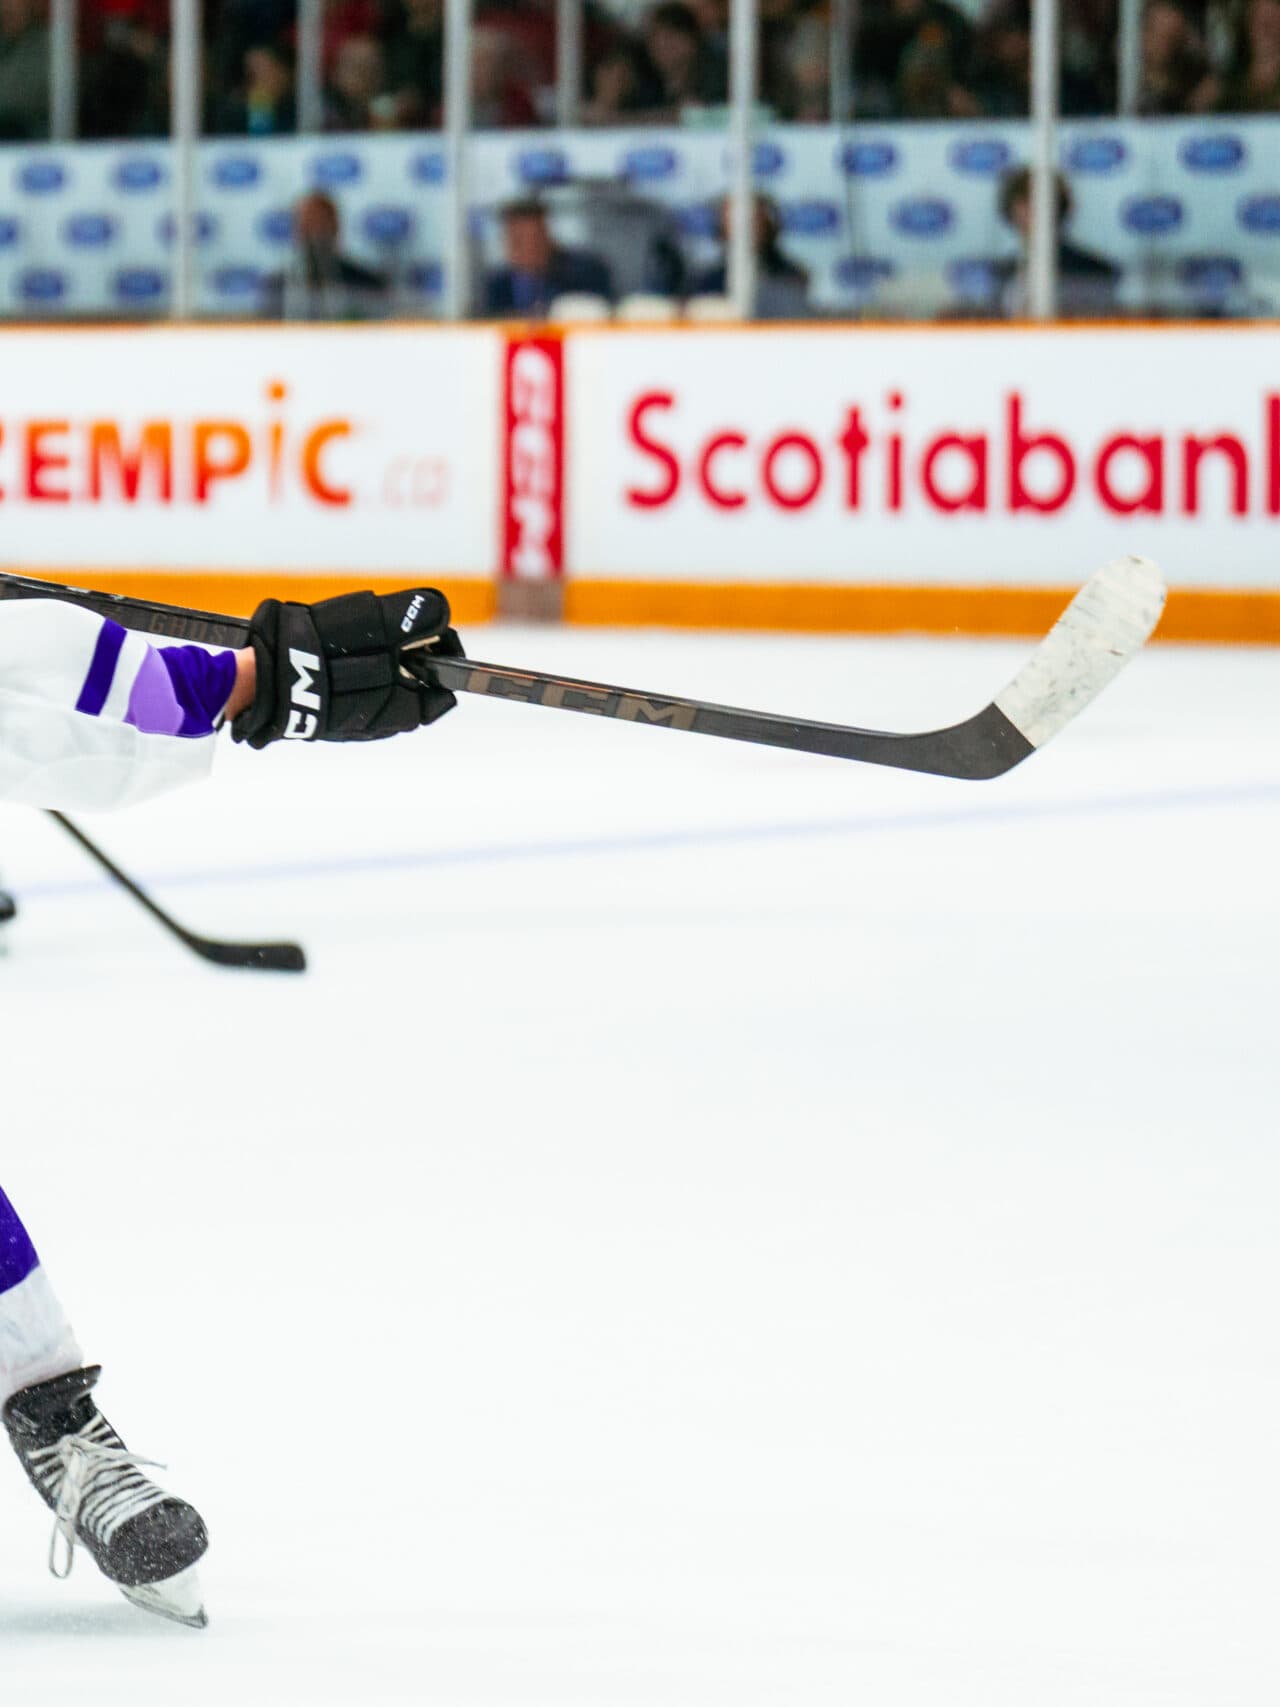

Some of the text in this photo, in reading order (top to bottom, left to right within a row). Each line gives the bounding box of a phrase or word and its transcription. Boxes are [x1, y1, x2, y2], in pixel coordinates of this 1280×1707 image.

[400, 594, 425, 633] CCM
[282, 647, 321, 741] CM
[464, 667, 698, 732] CCM
